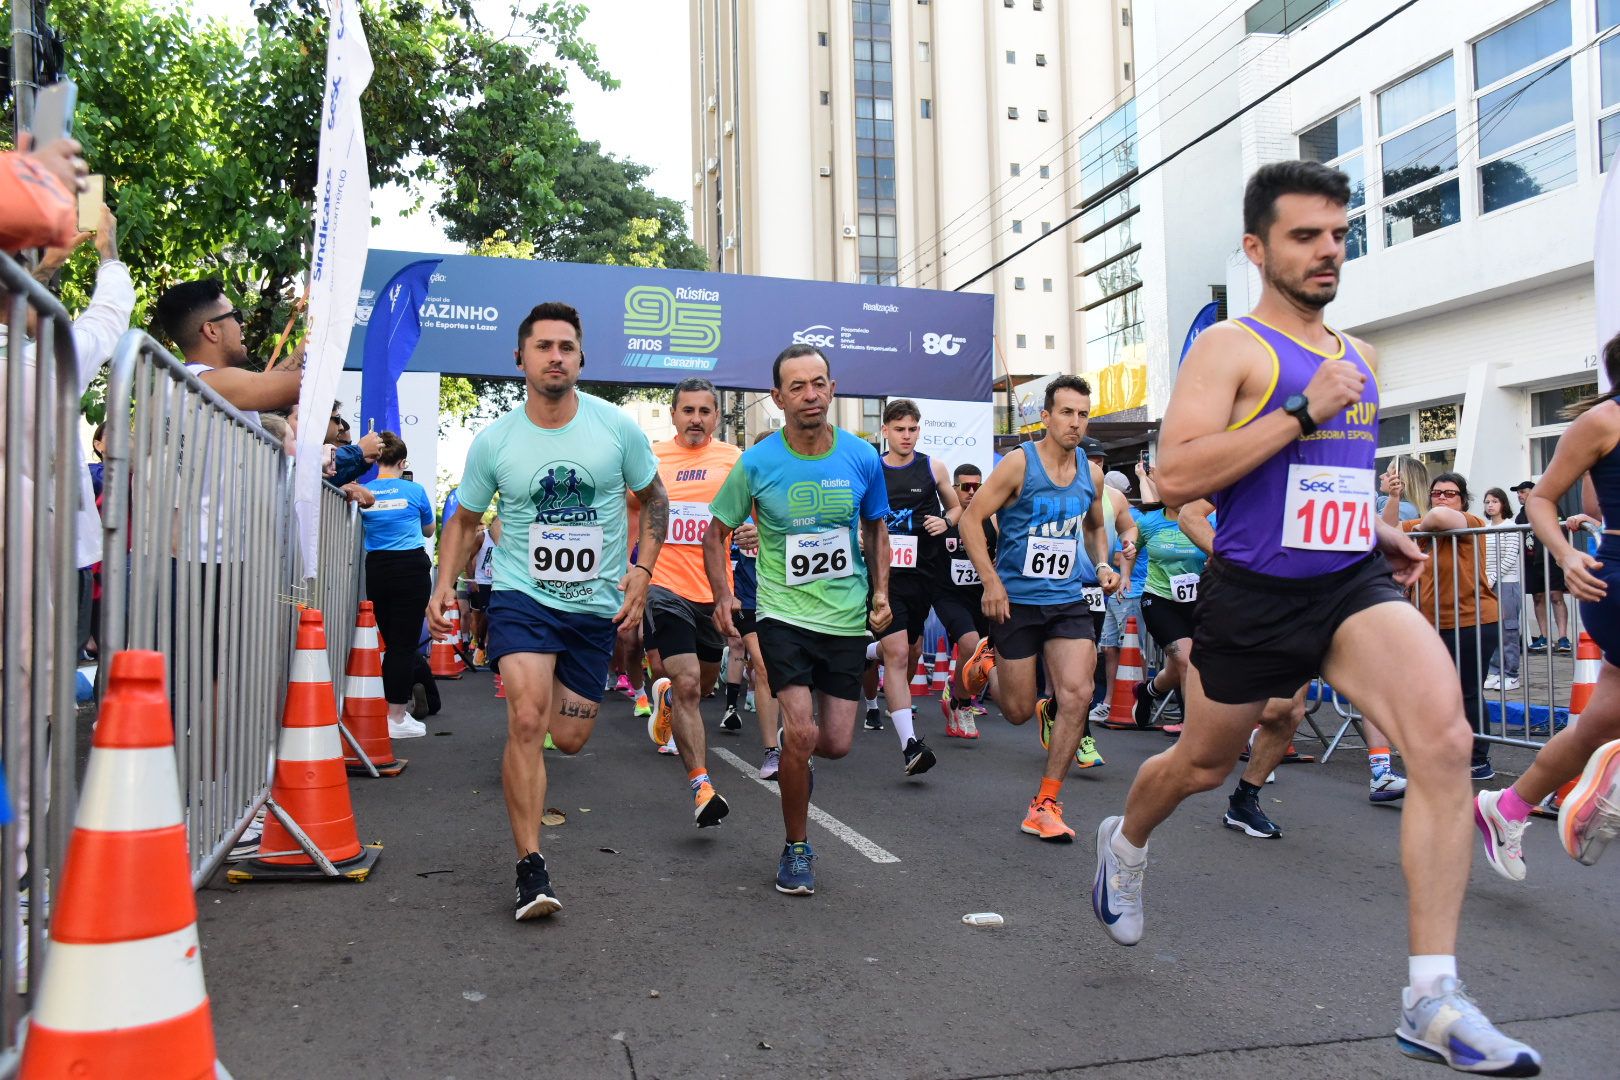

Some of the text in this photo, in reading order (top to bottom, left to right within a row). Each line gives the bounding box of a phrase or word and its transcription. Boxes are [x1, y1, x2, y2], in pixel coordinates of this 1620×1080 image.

[313, 167, 332, 282] Sindicatos
[675, 286, 720, 301] Rústica
[419, 304, 499, 321] RAZINHO
[862, 302, 899, 314] Realização:
[436, 322, 467, 330] Esportes
[624, 285, 722, 354] 95
[627, 337, 662, 351] anos
[792, 330, 835, 348] Sesc
[663, 356, 710, 368] Carazinho
[924, 419, 957, 428] Patrocínio:
[923, 434, 977, 446] SECCO
[676, 470, 707, 481] CORRE
[822, 479, 850, 488] Rústica
[1300, 478, 1335, 493] Sesc
[787, 481, 854, 523] 95
[793, 517, 816, 527] anos
[1029, 496, 1091, 538] RUN
[1296, 498, 1371, 546] 1074
[542, 531, 566, 540] Sesc
[666, 518, 709, 542] 088
[798, 540, 820, 548] Sesc
[1032, 543, 1050, 551] Sesc
[534, 546, 596, 572] 900
[791, 548, 847, 577] 926
[1032, 552, 1070, 576] 619
